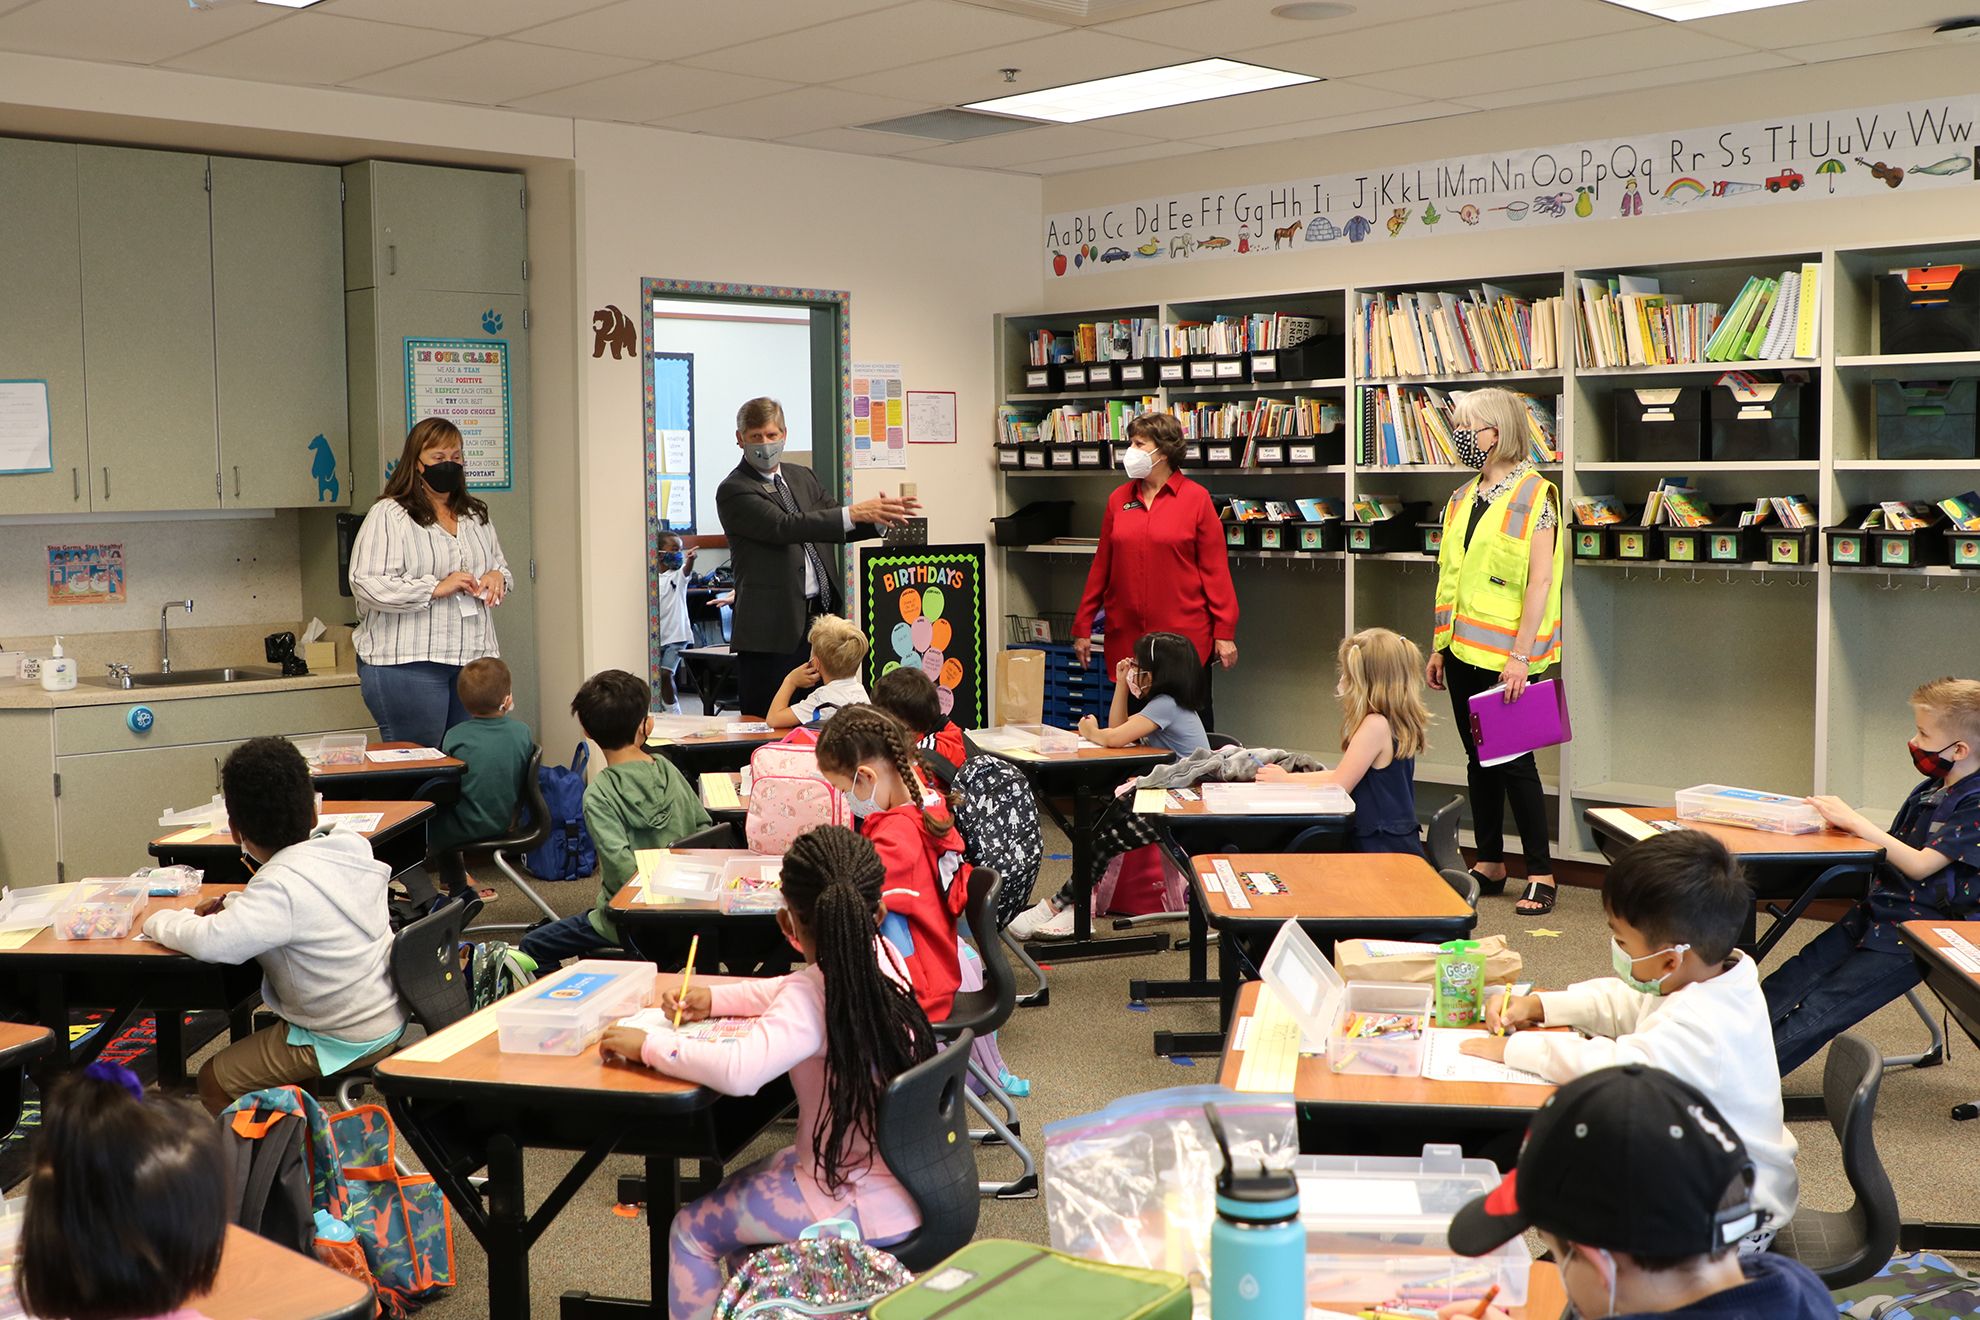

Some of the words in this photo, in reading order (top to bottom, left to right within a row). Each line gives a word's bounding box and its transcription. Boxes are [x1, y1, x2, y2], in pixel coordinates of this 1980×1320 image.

[417, 351, 432, 362] IN
[434, 351, 460, 362] OUR
[462, 352, 500, 364] CLASS
[882, 566, 964, 592] BIRTHDAYS
